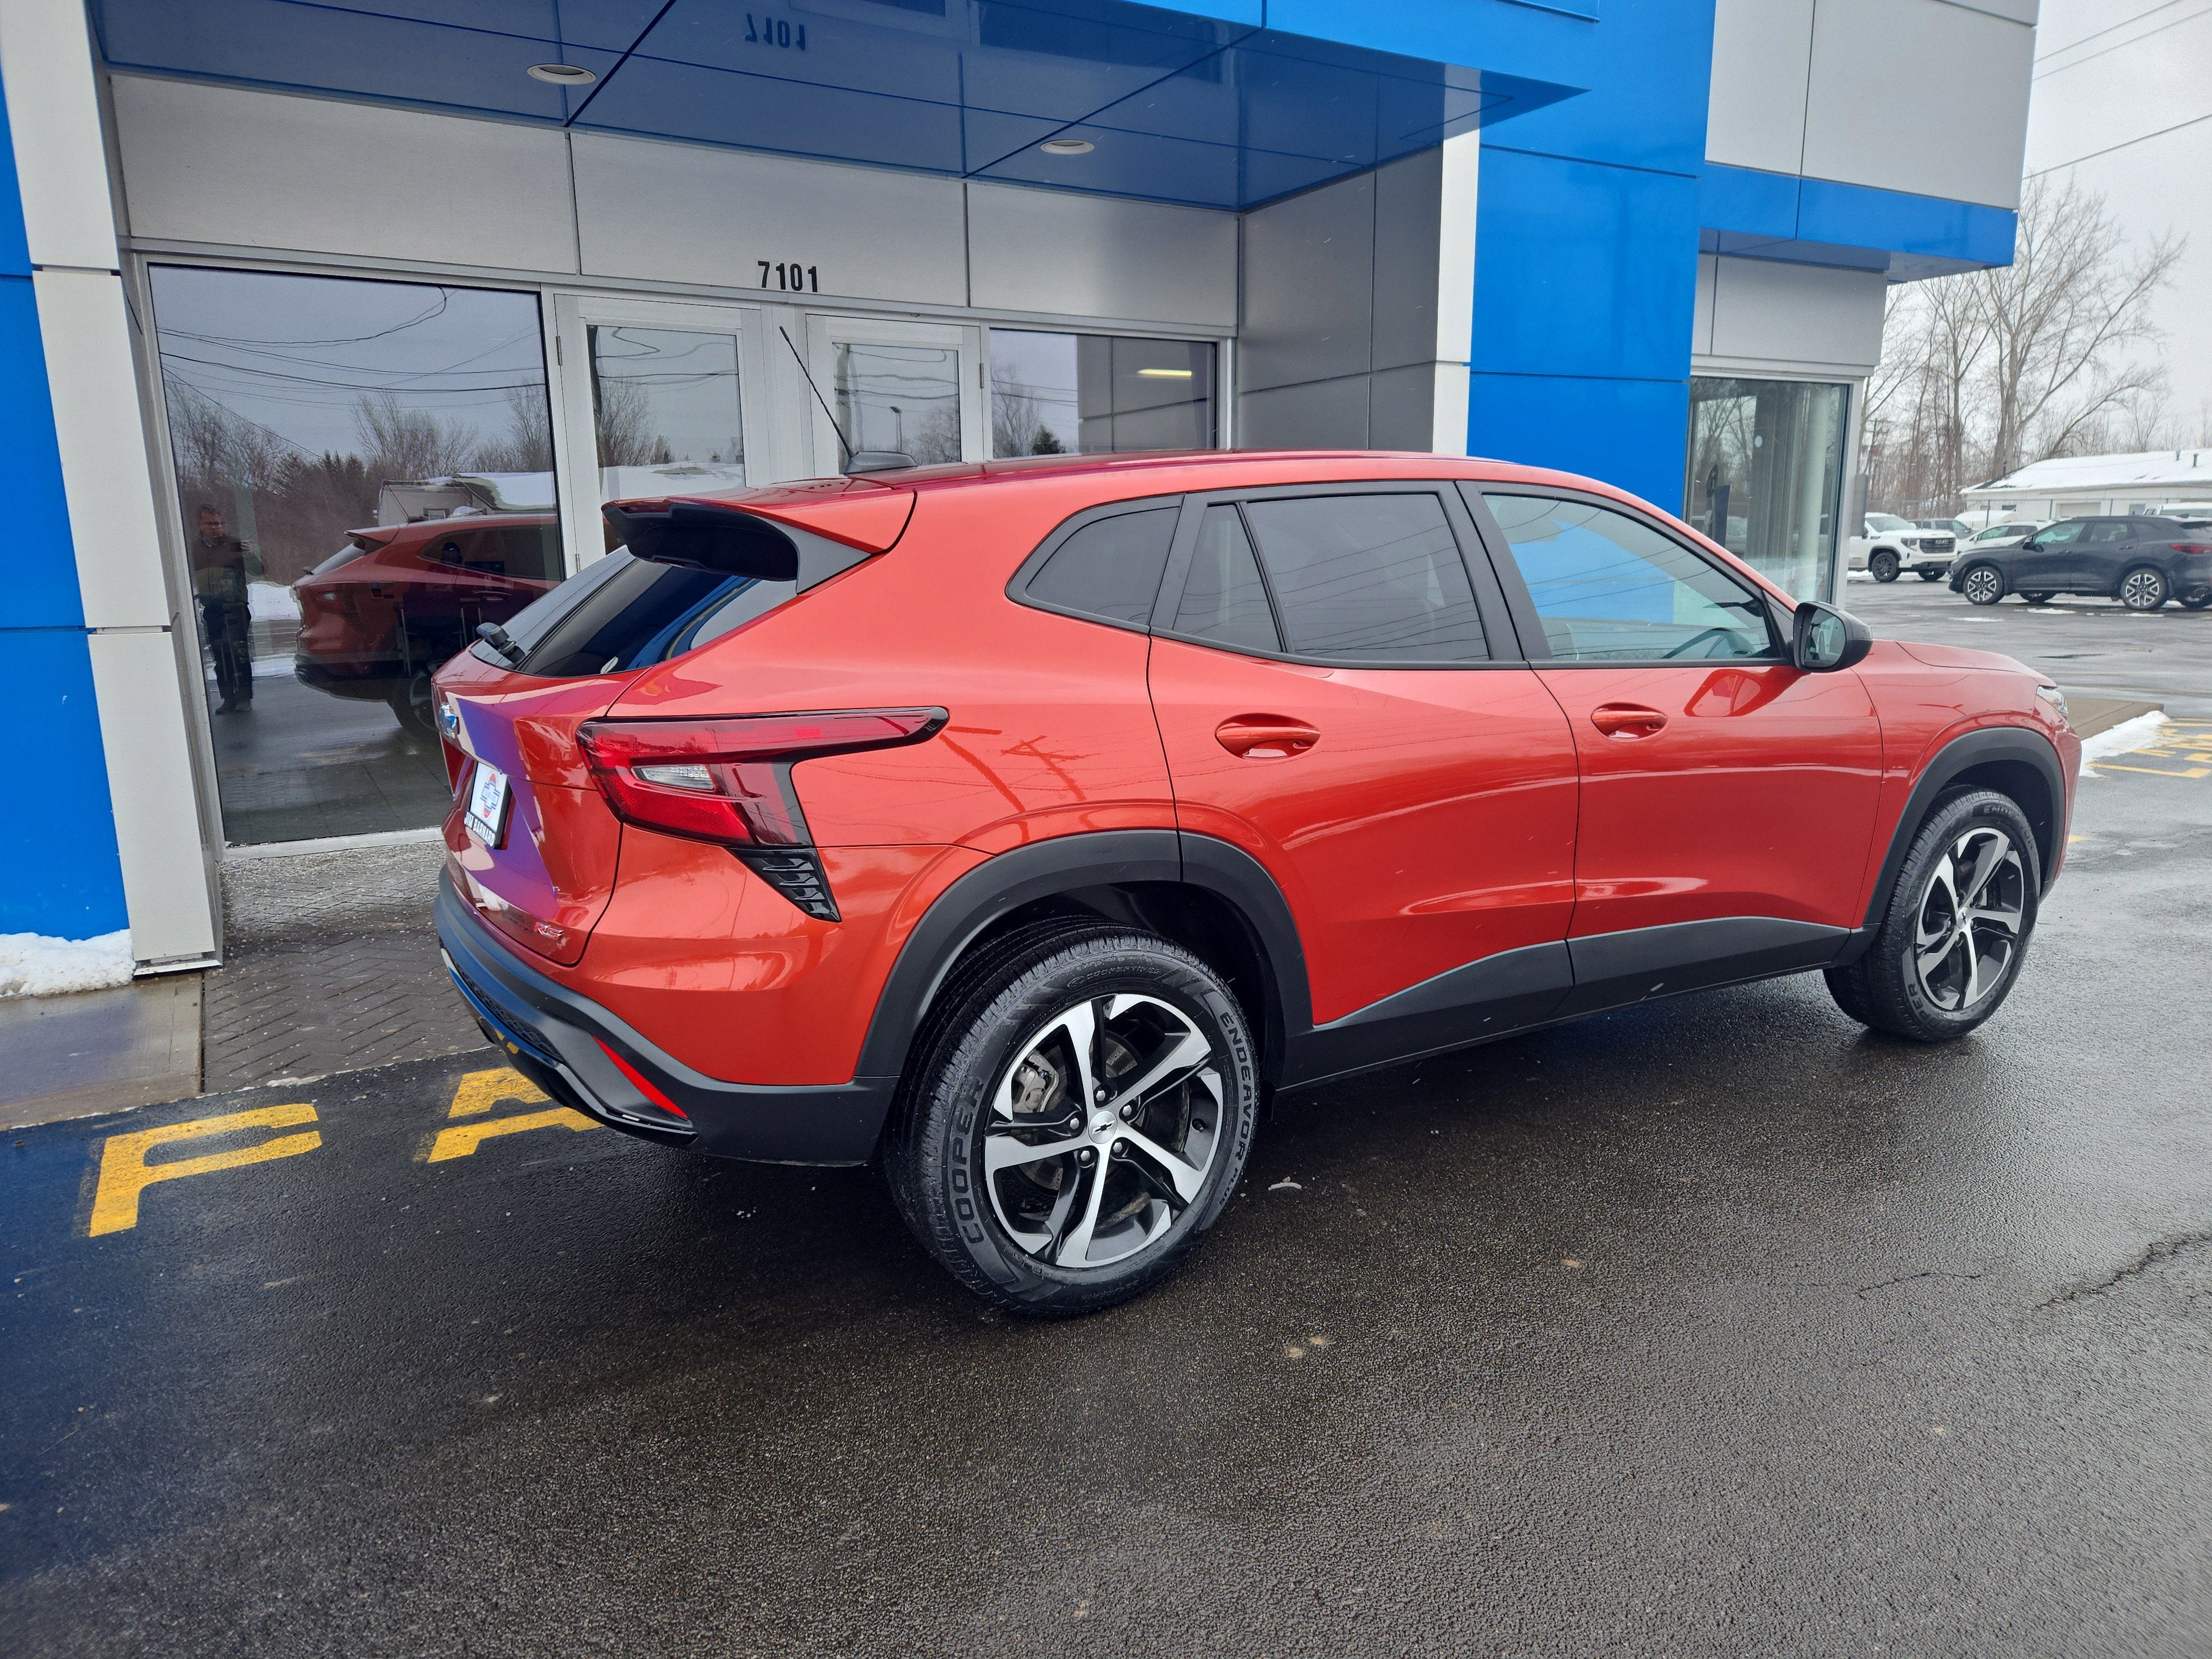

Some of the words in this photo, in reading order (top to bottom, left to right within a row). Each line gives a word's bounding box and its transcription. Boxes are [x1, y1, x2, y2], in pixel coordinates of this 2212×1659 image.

[757, 260, 818, 293] 7101
[534, 922, 563, 940] RS
[1220, 1011, 1252, 1162] ENDEAVOR
[951, 1077, 985, 1244] COOPER
